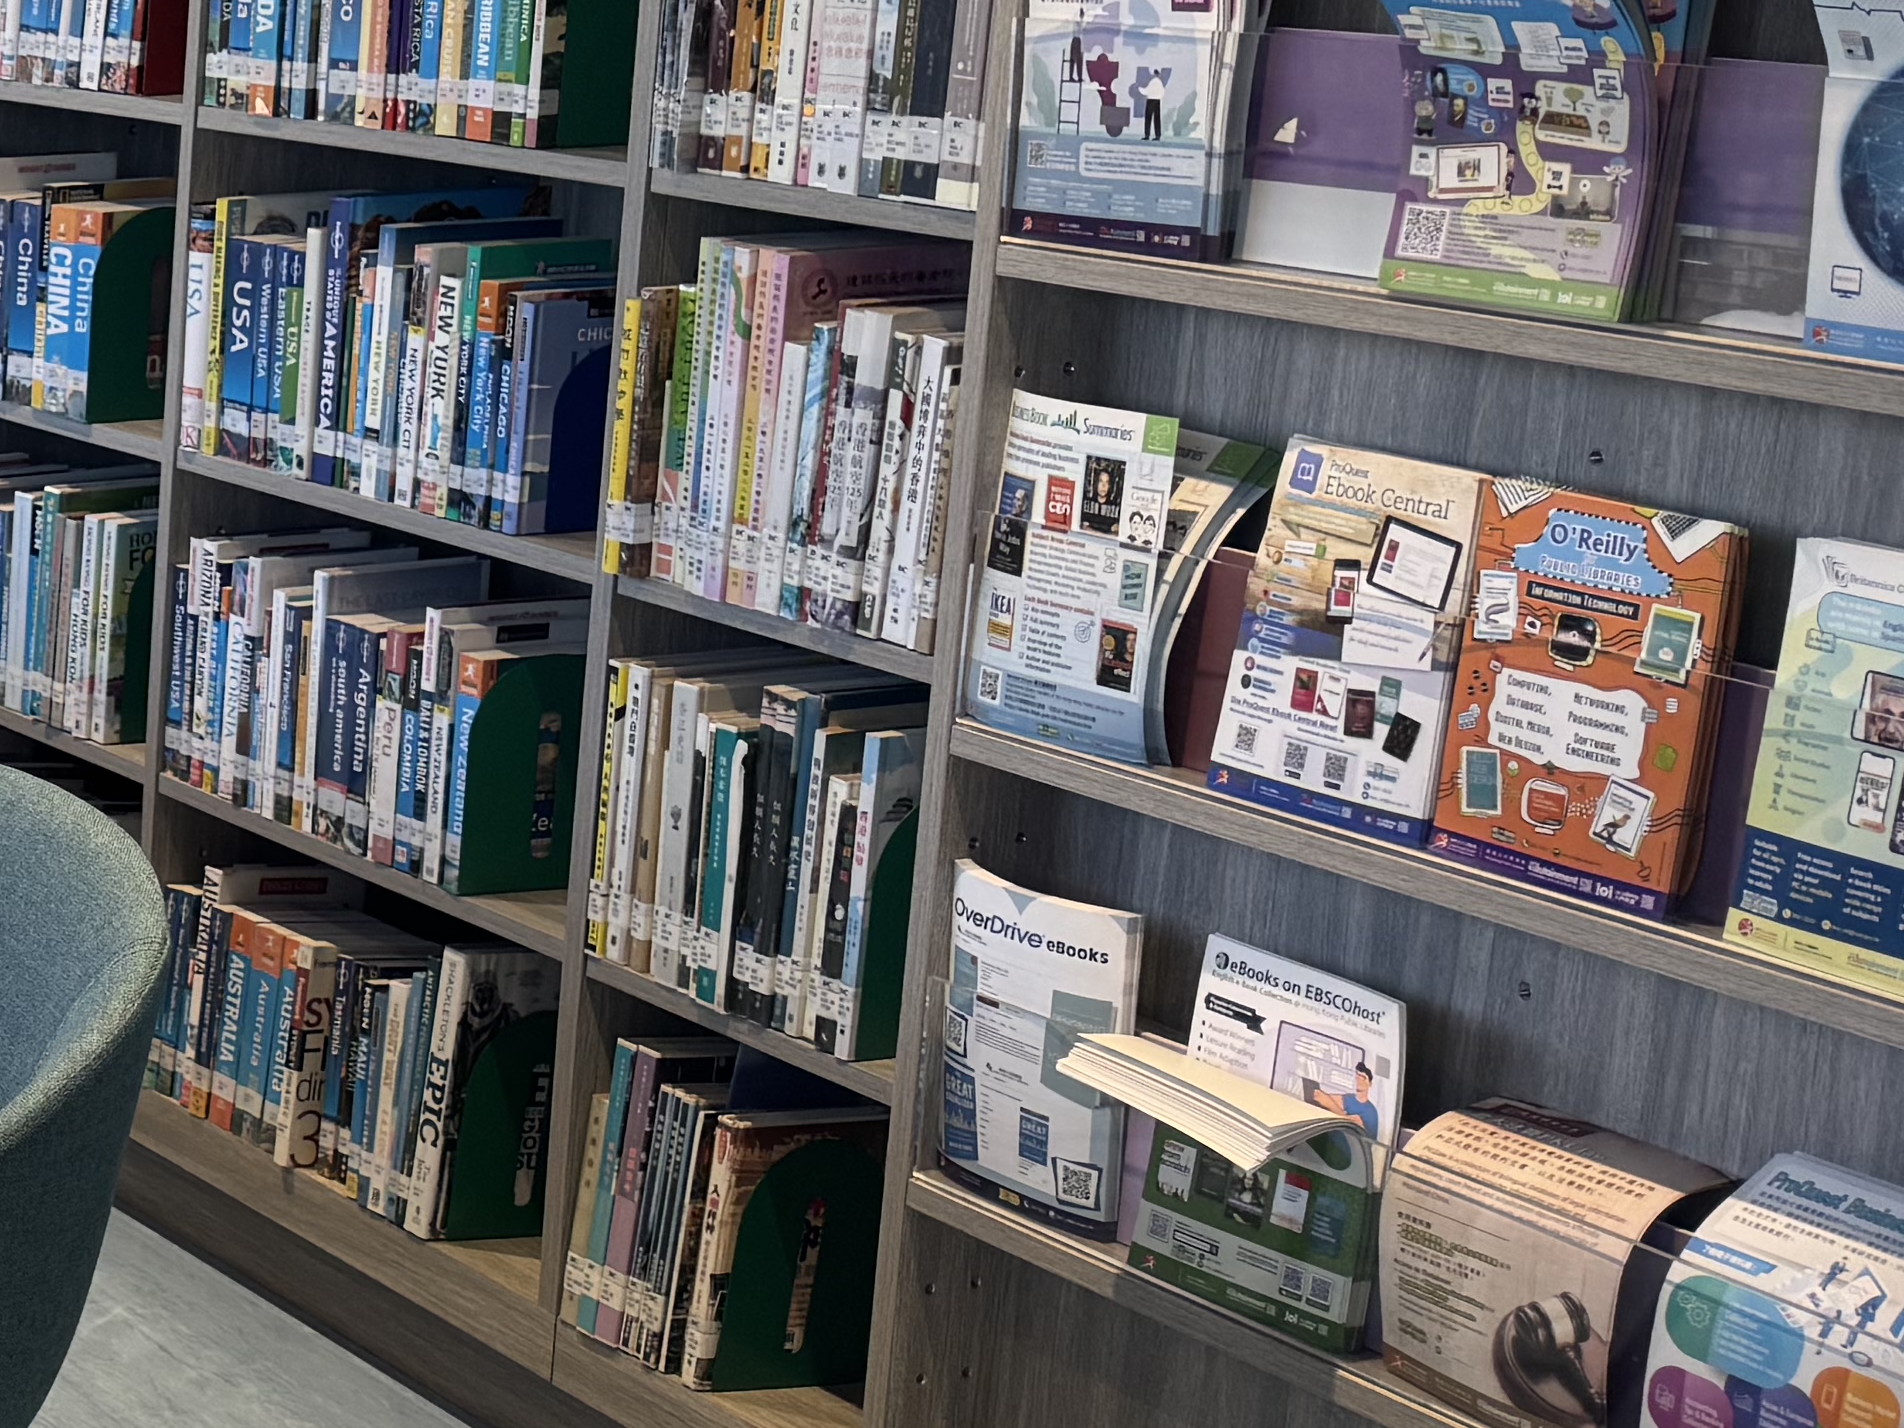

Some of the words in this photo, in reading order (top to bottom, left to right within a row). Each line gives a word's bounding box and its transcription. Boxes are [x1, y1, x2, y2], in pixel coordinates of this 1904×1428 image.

[410, 28, 422, 62] RICA
[424, 1, 439, 40] Rica
[15, 238, 33, 308] China
[46, 246, 73, 337] CHINA
[74, 257, 96, 335] China
[186, 262, 204, 319] USA
[230, 280, 253, 353] USA
[257, 283, 272, 343] Western
[437, 283, 457, 338] NEW
[255, 346, 269, 379] USA
[285, 326, 299, 367] USA
[317, 322, 340, 430] AMERICA
[430, 341, 451, 401] YORK
[479, 336, 490, 369] New
[272, 360, 283, 400] USA
[476, 371, 487, 403] York
[496, 365, 511, 439] CHICAGO
[473, 406, 484, 433] City
[1323, 476, 1376, 506] Ebook
[1380, 487, 1452, 521] Central
[1330, 459, 1370, 479] ProQuest
[1549, 523, 1641, 564] O'Reilly
[199, 546, 215, 609] ARIZONA
[1582, 595, 1635, 618] TECHNOLOGY
[1583, 563, 1642, 590] LIBRARIES
[172, 604, 186, 679] Southwest
[284, 643, 294, 667] San
[169, 680, 182, 709] USA
[225, 621, 245, 739] CALIFORNIA
[238, 639, 253, 714] CALIFORNIA
[280, 669, 293, 732] Francisco
[352, 668, 372, 775] Argentina
[381, 708, 396, 758] Peru
[419, 699, 432, 725] BALI
[460, 707, 476, 753] New
[400, 713, 415, 793] COLOMBIA
[414, 741, 428, 793] LOMBOK
[452, 755, 469, 835] Zealand
[193, 875, 220, 976] AUSTRALIA
[955, 897, 1044, 948] OverDrive
[1046, 940, 1109, 964] eBooks
[219, 954, 246, 1064] AUSTRALIA
[1230, 960, 1280, 988] eBooks
[1283, 979, 1301, 995] on
[1305, 983, 1382, 1025] EBSCOhost
[251, 978, 271, 1068] Australia
[271, 984, 295, 1093] Australia
[331, 996, 347, 1056] Tasmania
[356, 1036, 370, 1080] MAUI
[420, 1052, 450, 1149] EPIC
